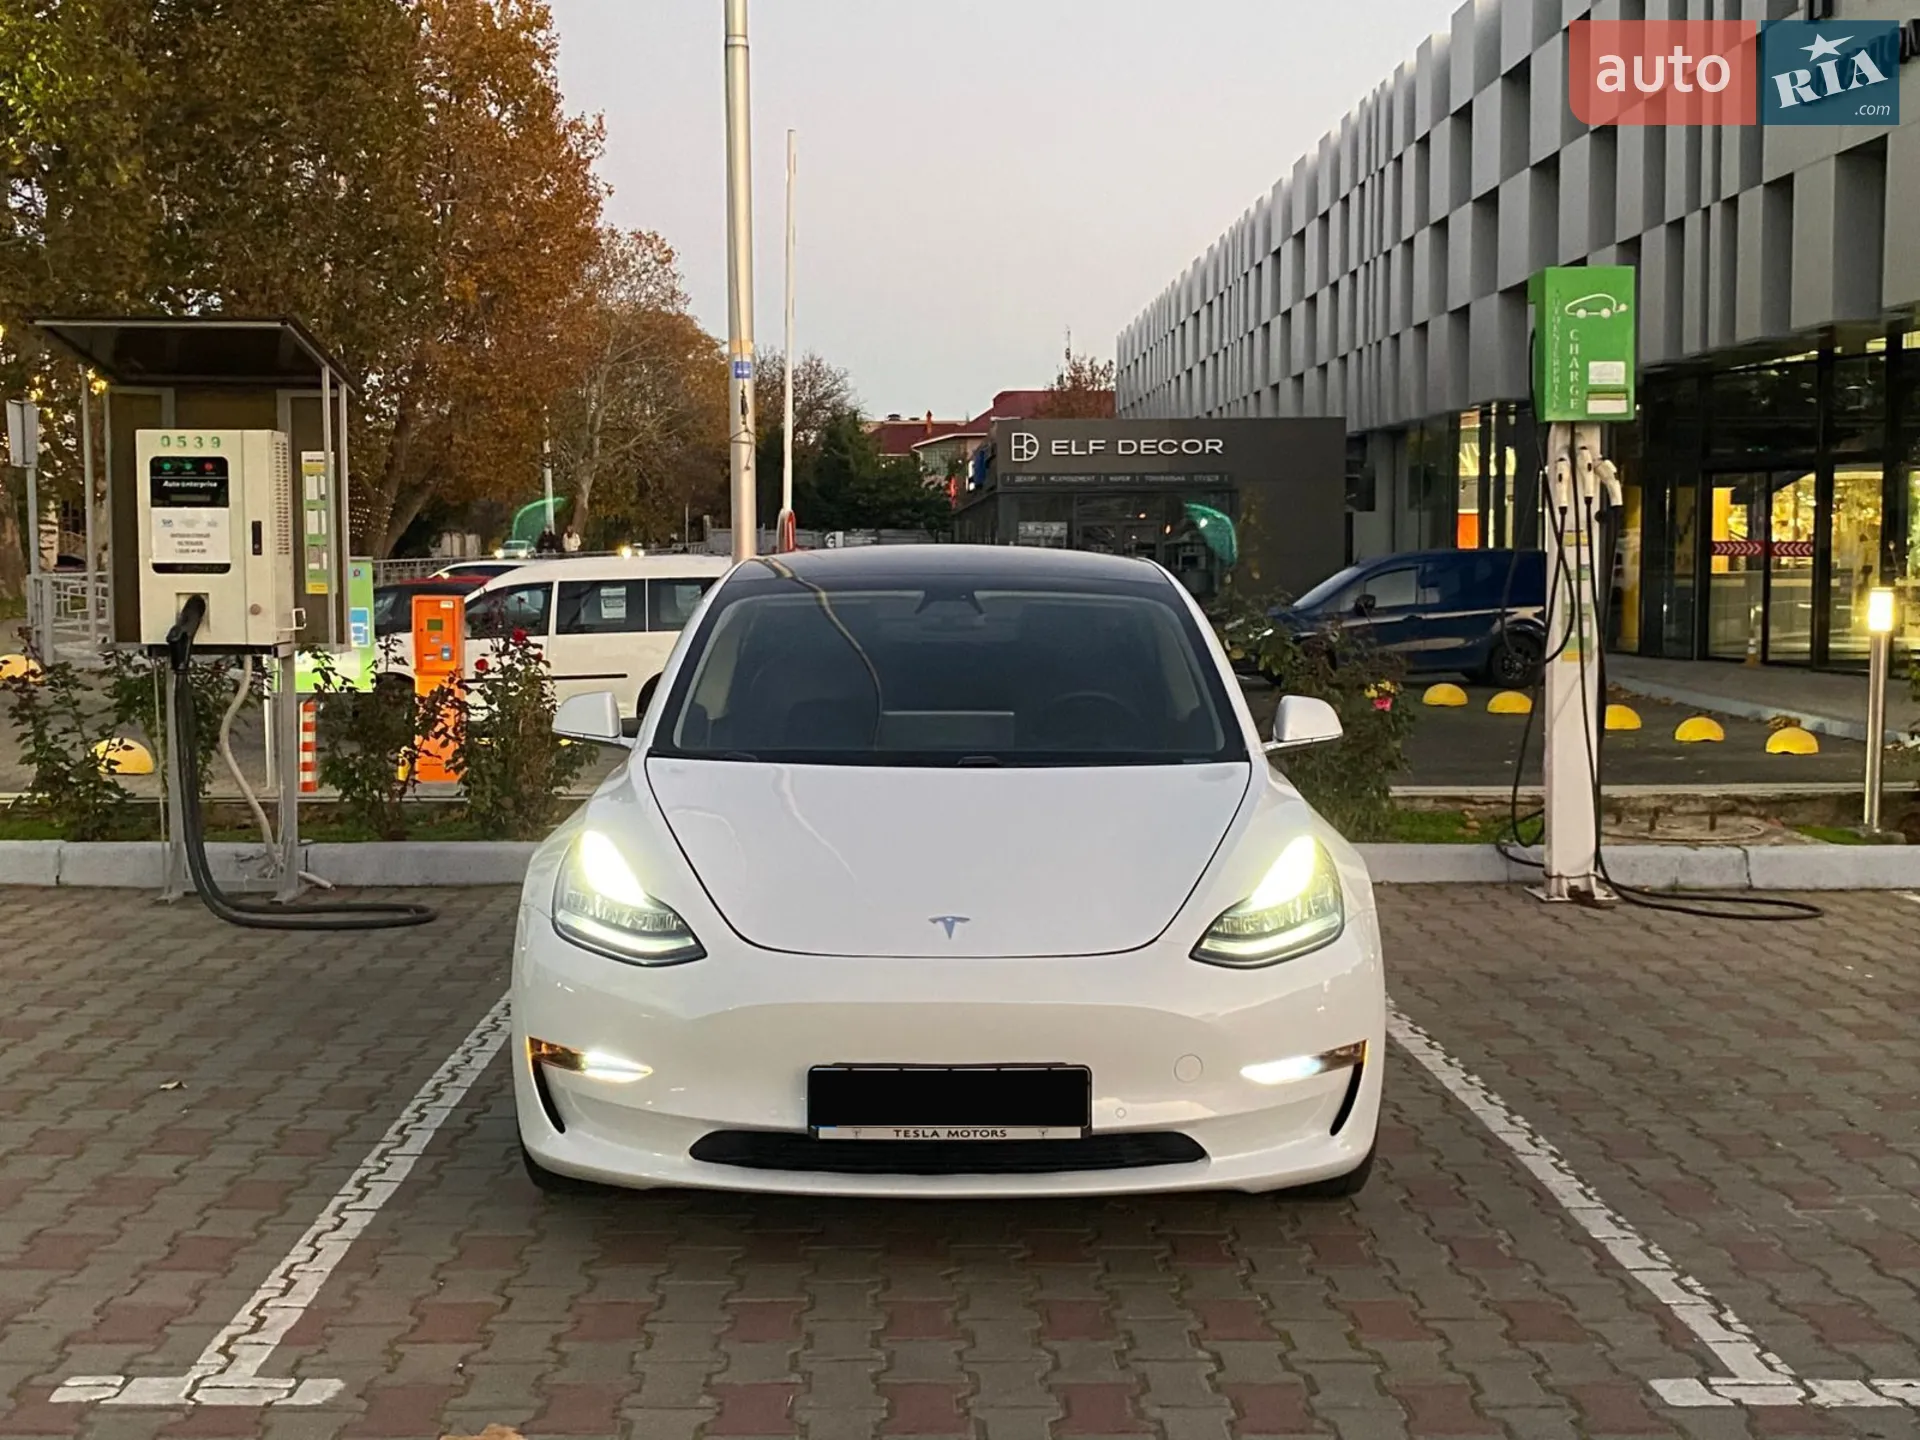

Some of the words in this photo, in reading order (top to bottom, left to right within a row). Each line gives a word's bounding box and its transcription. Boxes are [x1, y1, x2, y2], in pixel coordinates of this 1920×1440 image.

[1569, 329, 1580, 410] CHARGE
[161, 435, 221, 449] 0539
[1051, 440, 1107, 456] ELF
[1118, 439, 1224, 455] DECOR
[893, 1129, 940, 1138] TESLA
[947, 1129, 1008, 1138] MOTORS
